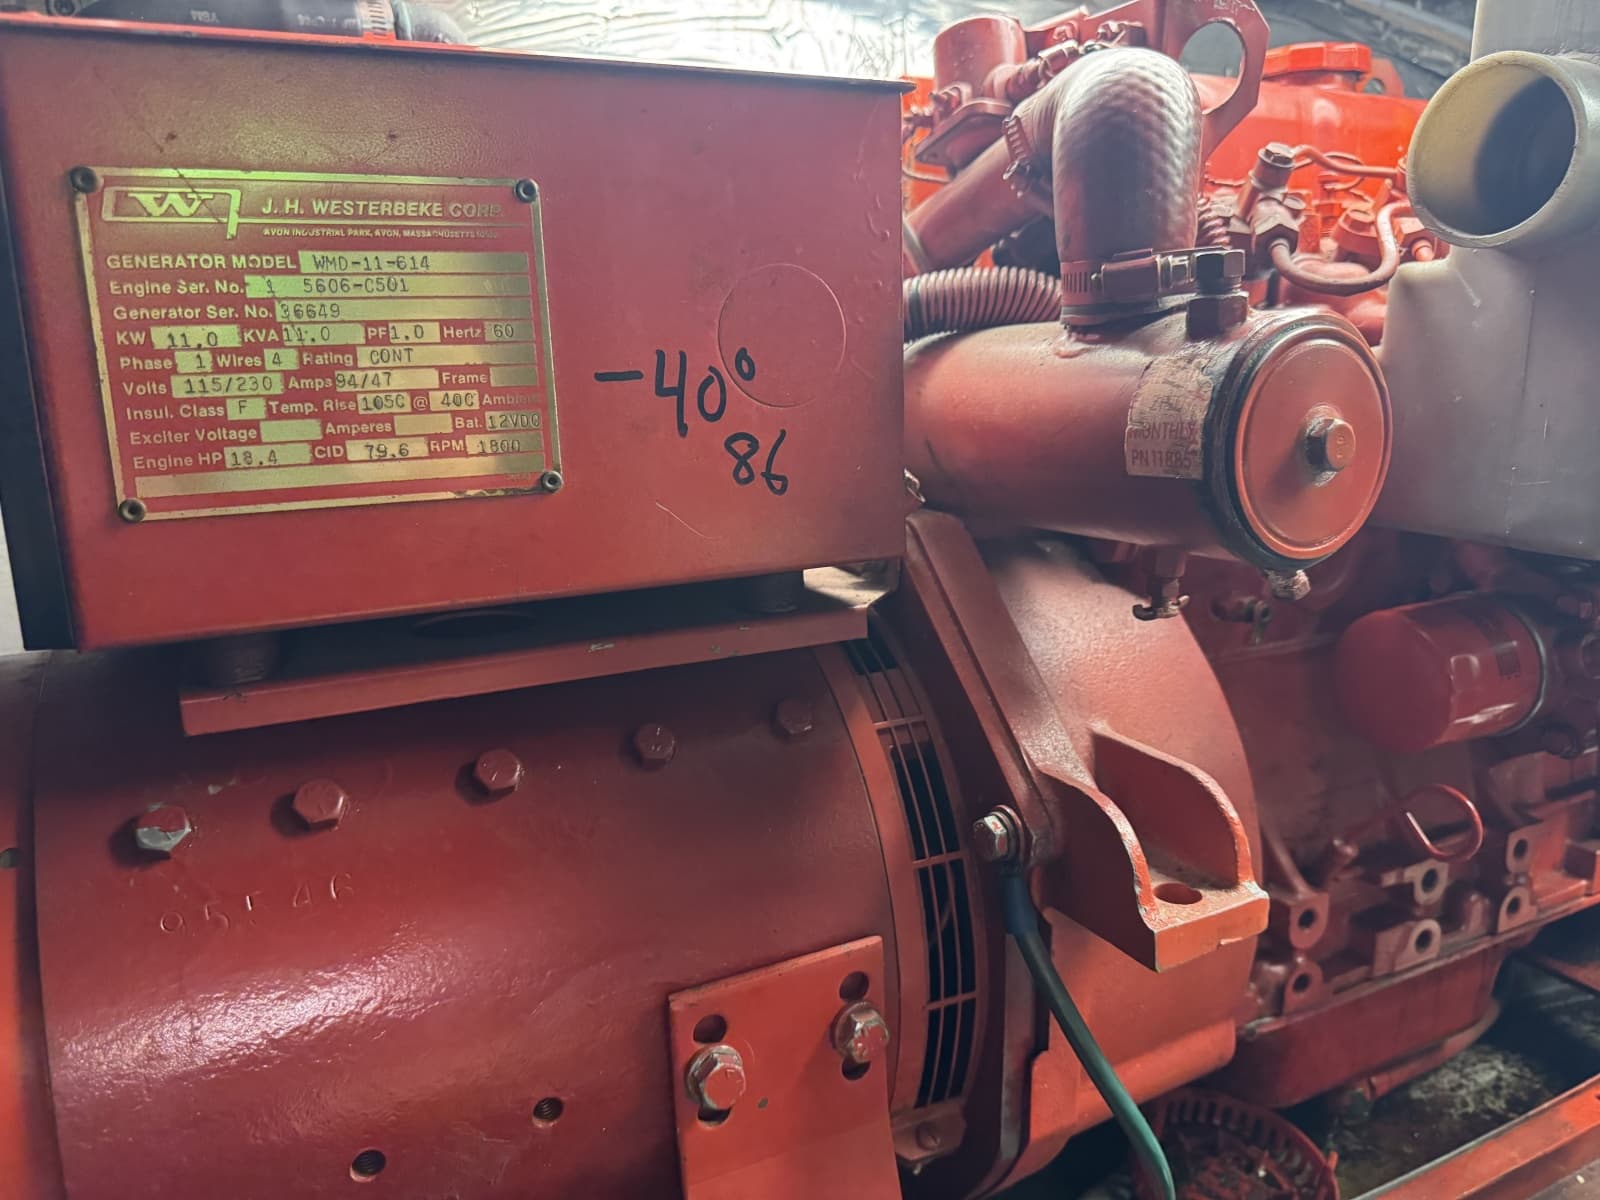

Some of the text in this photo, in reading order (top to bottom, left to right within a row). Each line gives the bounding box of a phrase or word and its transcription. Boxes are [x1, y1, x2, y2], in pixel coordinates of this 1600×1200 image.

[262, 199, 278, 214] J.
[285, 199, 304, 214] H.
[312, 199, 443, 217] WESTERBEKE
[264, 228, 290, 237] AVON
[106, 254, 430, 271] GENERATOR MODEL WMD-11-614
[109, 280, 172, 298] Engine
[176, 279, 210, 294] Ser.
[214, 279, 244, 294] No.
[303, 276, 409, 294] 5606-C501
[113, 303, 341, 321] Generator Ser. No. 36649
[116, 330, 146, 345] KW
[167, 331, 219, 350] 11.0
[243, 328, 279, 343] KVA
[367, 327, 387, 340] PF
[390, 324, 424, 341] 1.0
[443, 326, 481, 339] Hertz
[493, 324, 514, 338] 60
[120, 347, 413, 371] Phase 1 Wires 4 Rating CONT
[122, 370, 488, 396] Volts 115/230 Amps 94/47 Frame
[126, 405, 174, 421] Insul.
[179, 403, 225, 419] Class
[238, 399, 248, 415] F
[268, 400, 319, 416] Temp.
[322, 398, 357, 412] Rise
[413, 396, 428, 410] @
[440, 392, 475, 408] 40C
[130, 430, 190, 445] Exciter
[195, 427, 257, 443] Voltage
[325, 421, 393, 437] Amperes
[455, 416, 483, 429] Bat.
[133, 438, 521, 471] Engine HP 18.4 CID 79.6 RPM 1800
[724, 429, 790, 495] 86
